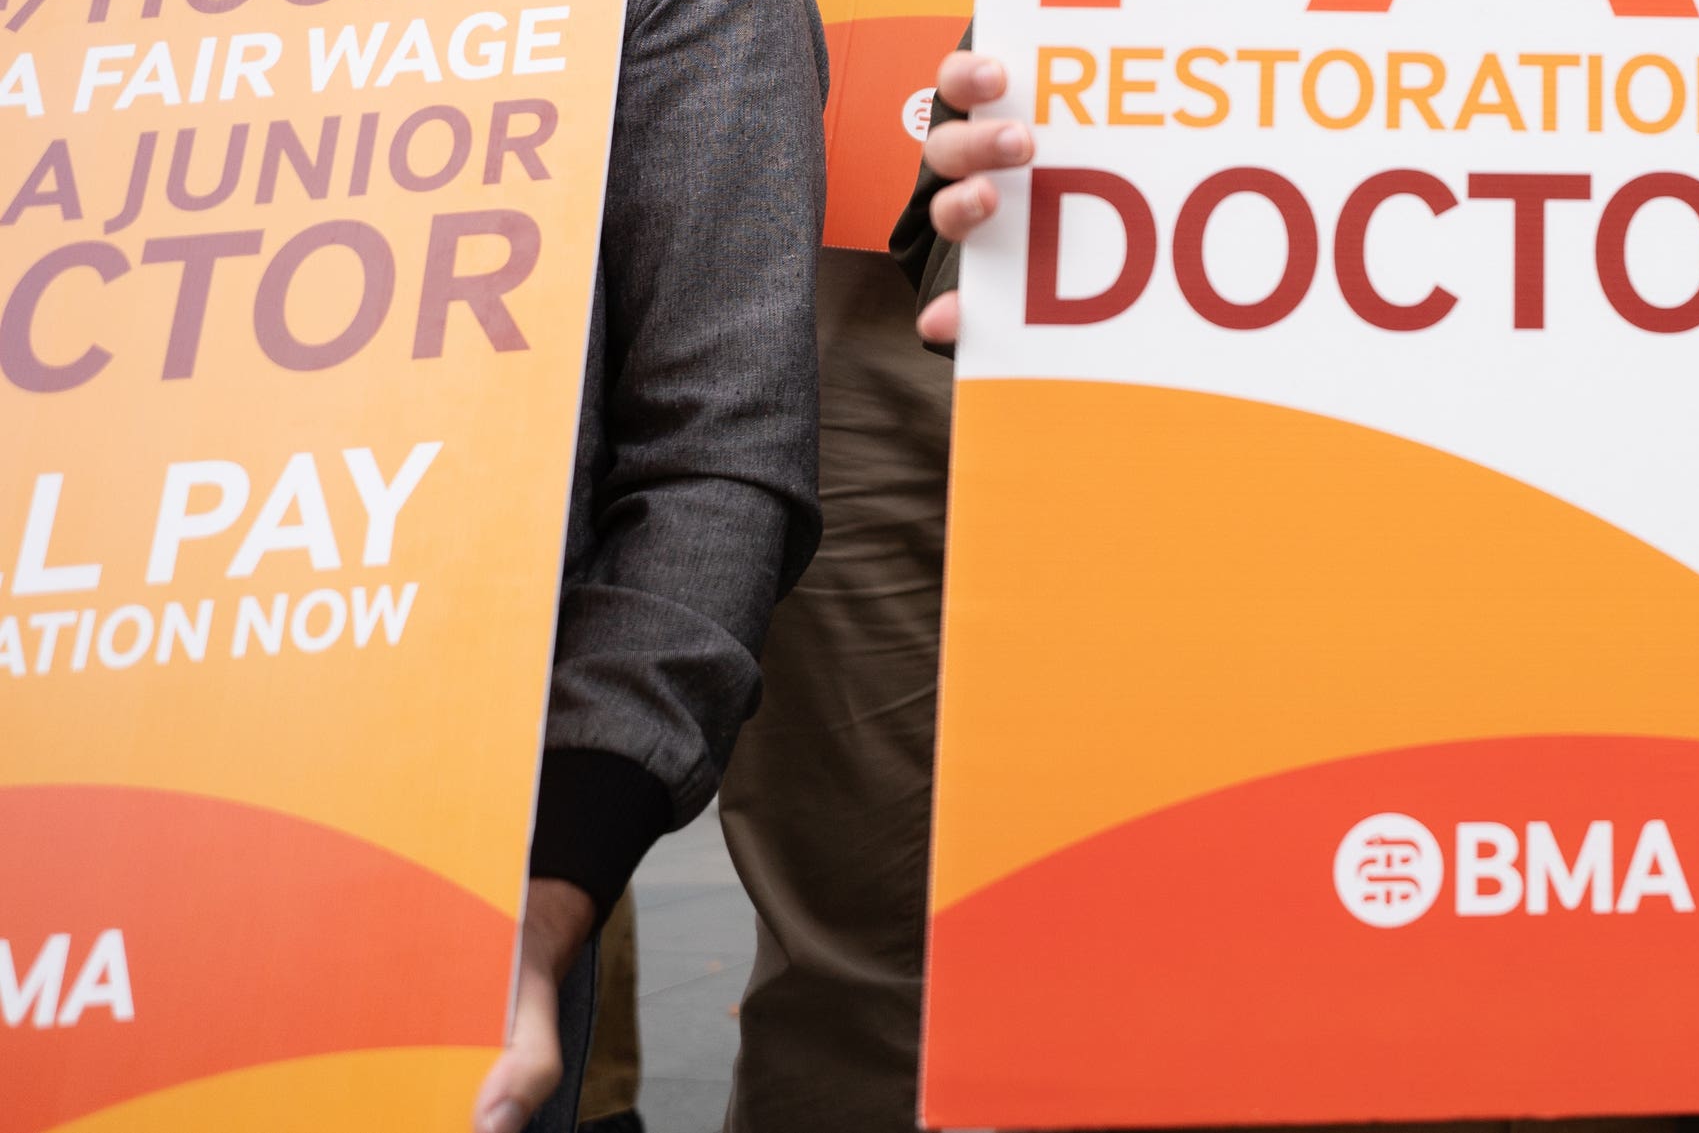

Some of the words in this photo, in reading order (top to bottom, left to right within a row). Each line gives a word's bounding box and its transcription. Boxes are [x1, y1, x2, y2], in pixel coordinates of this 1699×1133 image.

[0, 52, 45, 118] A
[72, 31, 282, 115] FAIR
[308, 4, 571, 94] WAGE
[0, 138, 84, 227] A
[103, 97, 560, 235] JUNIOR
[144, 440, 444, 586] PAY
[230, 581, 421, 660] NOW
[1454, 819, 1697, 916] BMA
